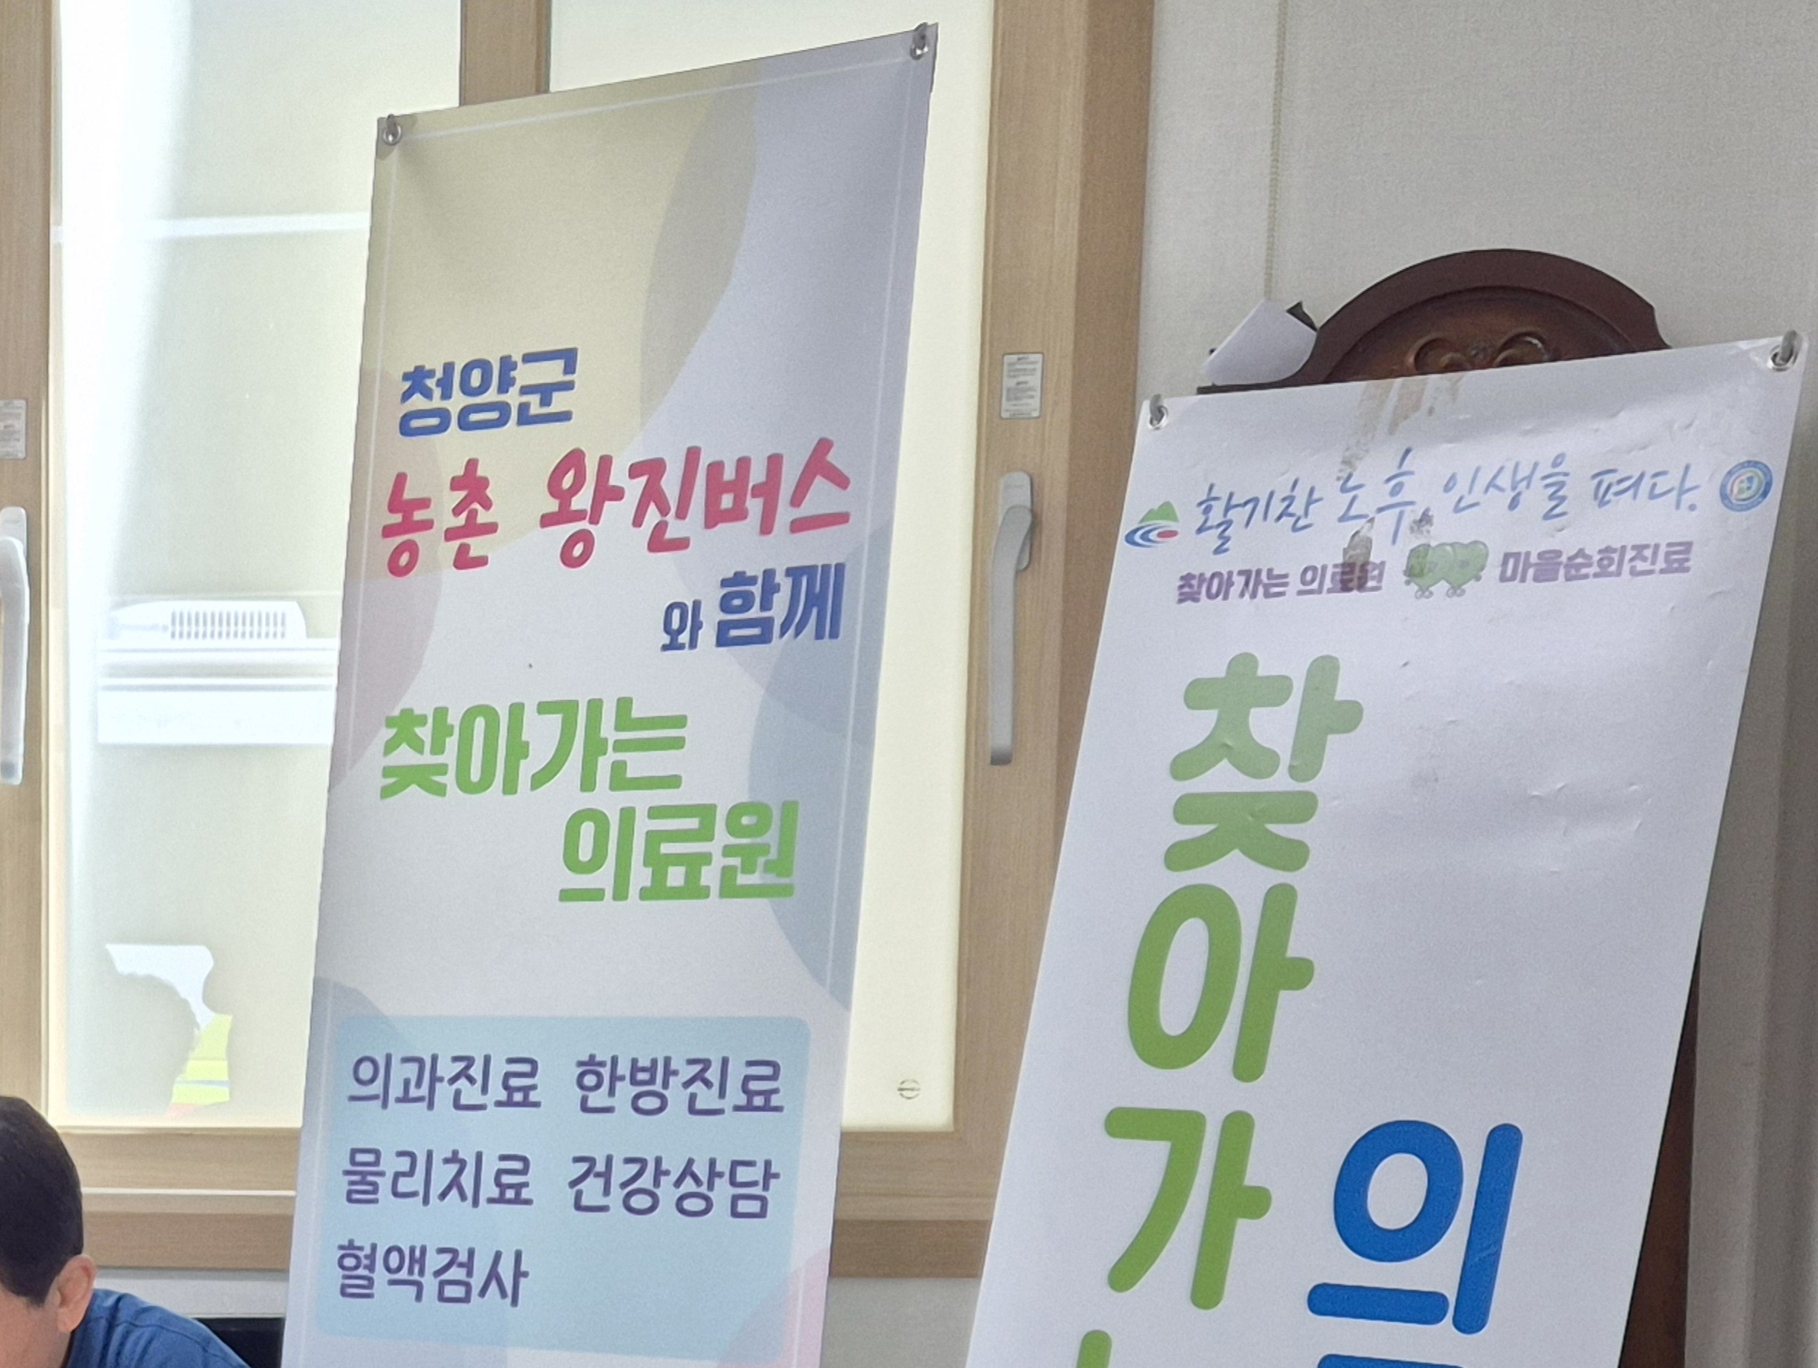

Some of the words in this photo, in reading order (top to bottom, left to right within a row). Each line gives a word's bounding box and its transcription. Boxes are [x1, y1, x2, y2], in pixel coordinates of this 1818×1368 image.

[398, 347, 578, 437] 청양군
[381, 457, 498, 577] 농촌
[539, 436, 851, 568] 왕진버스
[1195, 477, 1324, 555] 활기찬
[1443, 453, 1571, 521] 인생을
[1591, 463, 1701, 513] 펴다.
[660, 599, 703, 652] 와
[715, 562, 846, 648] 함께
[1177, 567, 1290, 605] 찾아가는
[1498, 541, 1694, 583] 마을순회진료
[380, 696, 688, 800] 찾아가는
[558, 800, 799, 903] 의료원
[347, 1052, 541, 1111] 의과진료
[574, 1053, 784, 1116] 한방진료
[342, 1147, 534, 1208] 물리치료
[567, 1154, 780, 1219] 건강상담
[336, 1238, 529, 1308] 혈액검사
